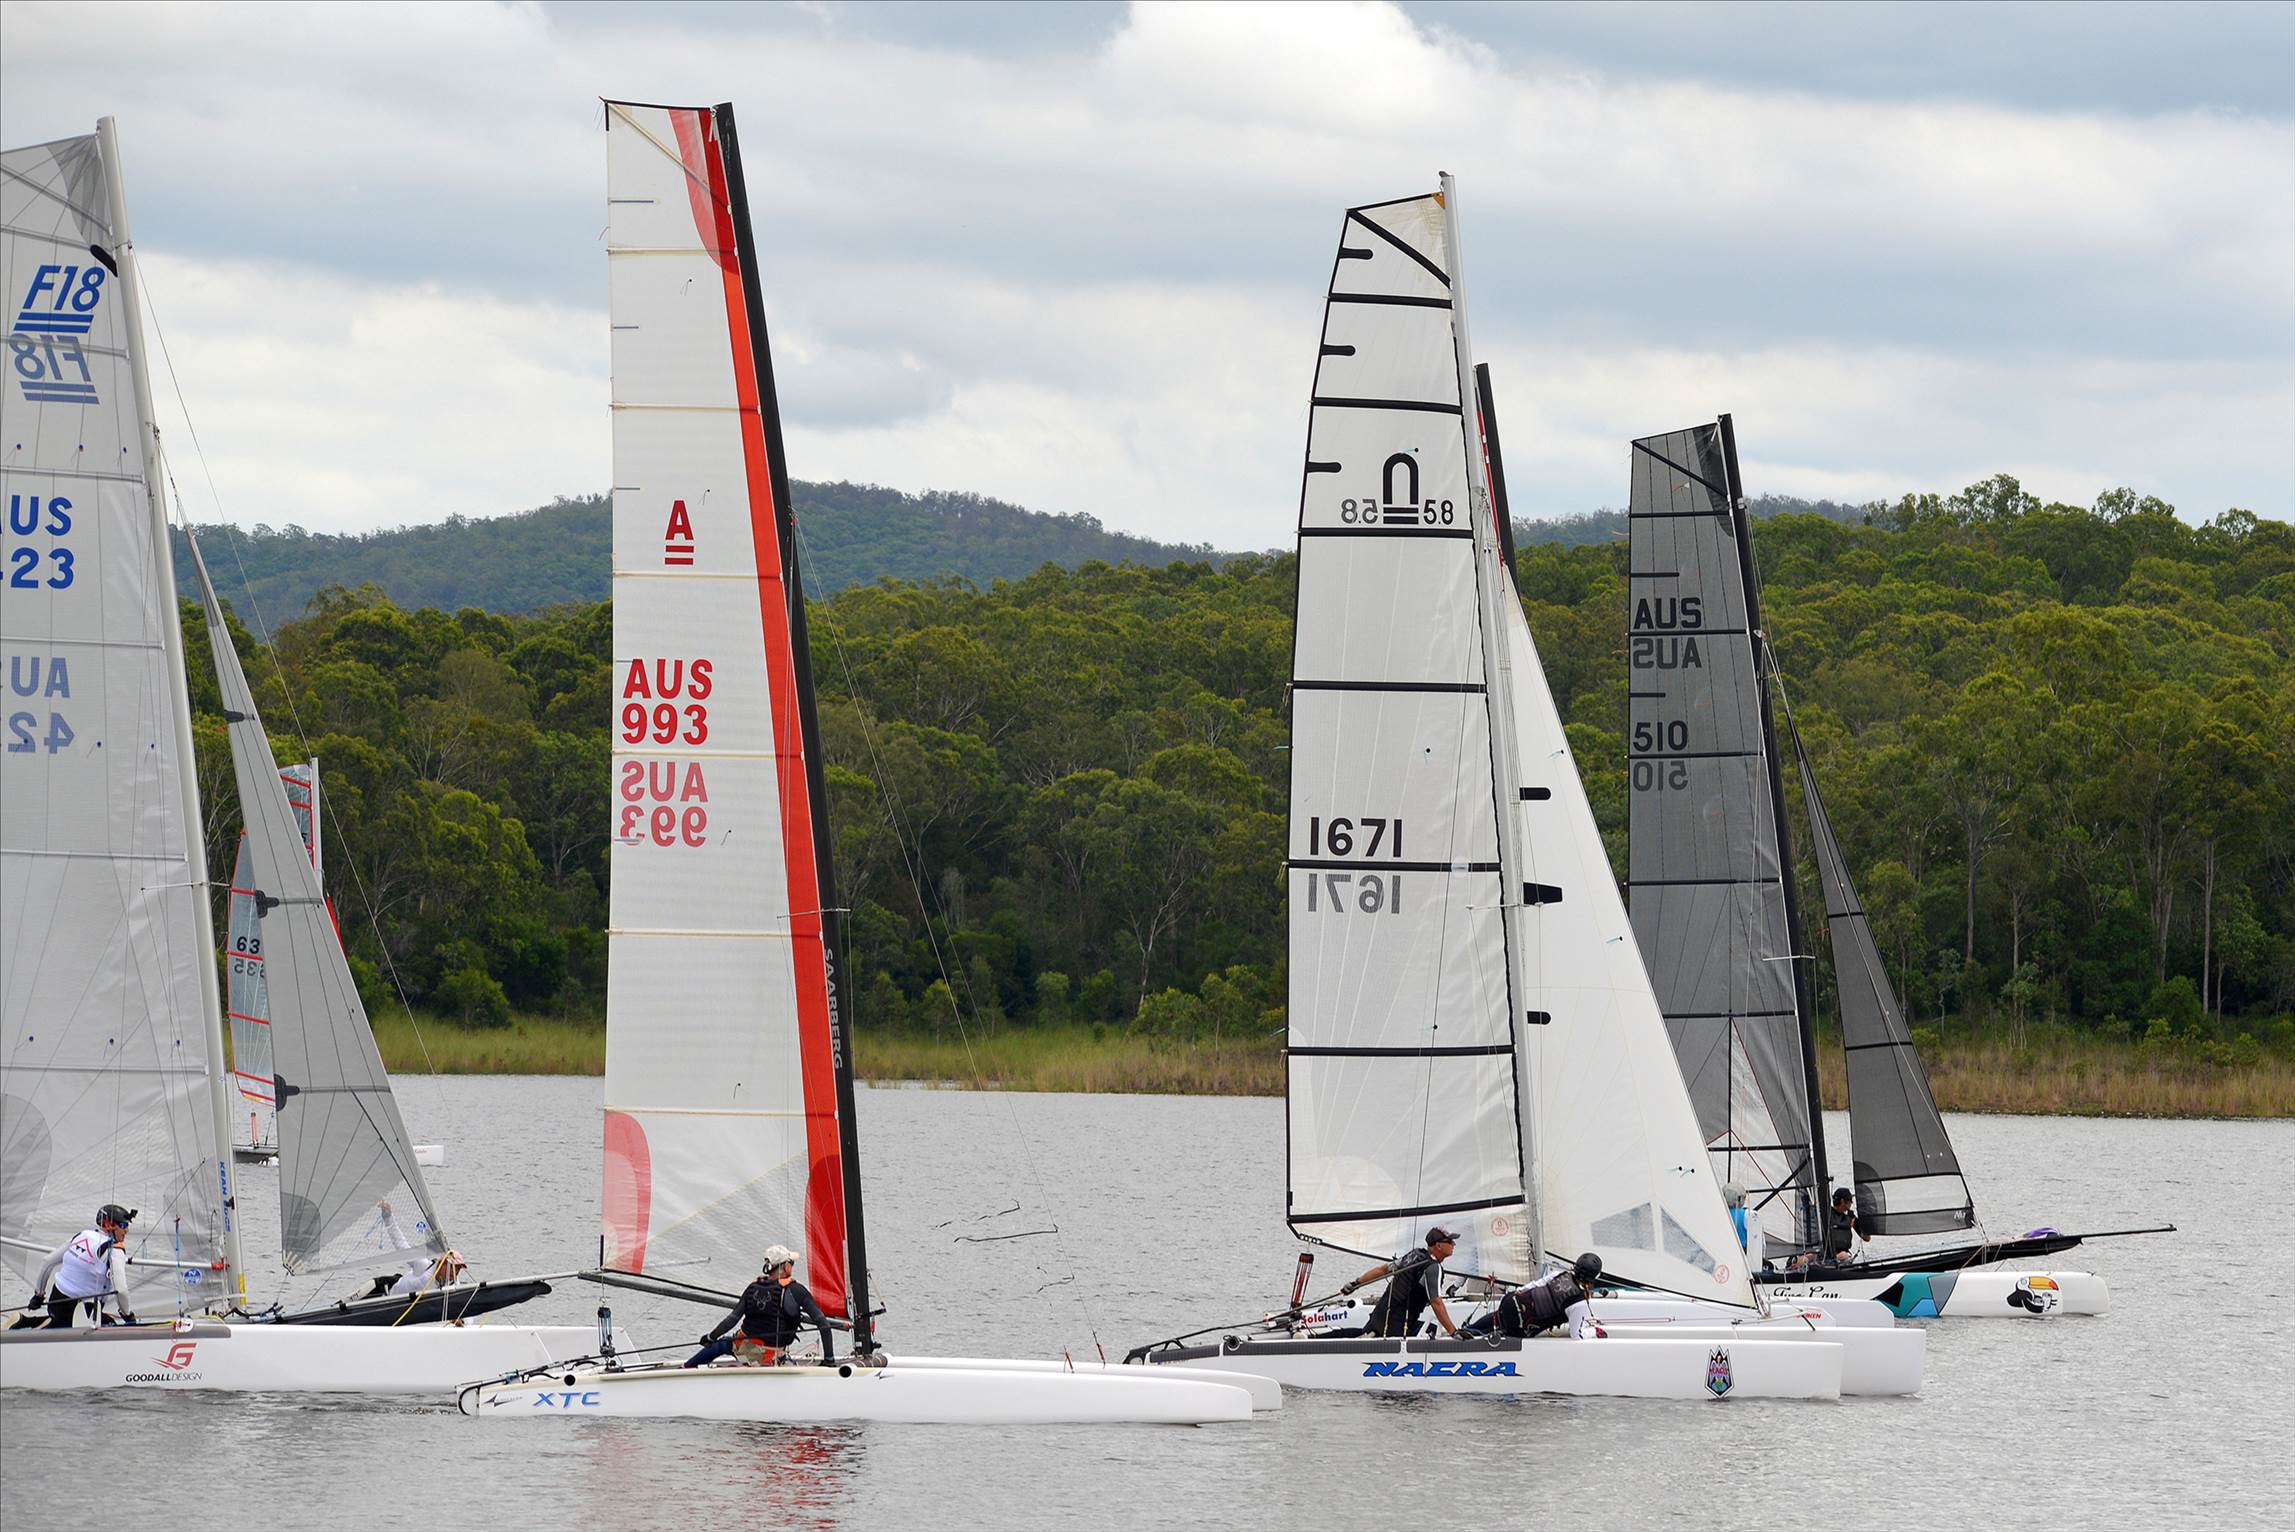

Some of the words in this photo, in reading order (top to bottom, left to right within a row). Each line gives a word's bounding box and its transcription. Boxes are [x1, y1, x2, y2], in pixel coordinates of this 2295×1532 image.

[22, 264, 106, 312] F18
[0, 495, 73, 537] US
[665, 500, 694, 540] A
[1423, 499, 1454, 525] 5.8
[0, 547, 75, 590] 23
[1633, 597, 1702, 630] AUS
[623, 658, 713, 700] AUS
[622, 703, 709, 745] 993
[1632, 720, 1689, 752] 510
[1309, 816, 1403, 858] 1671
[236, 936, 260, 954] 63
[824, 948, 843, 1069] SAARBERG
[532, 1391, 600, 1409] XTC
